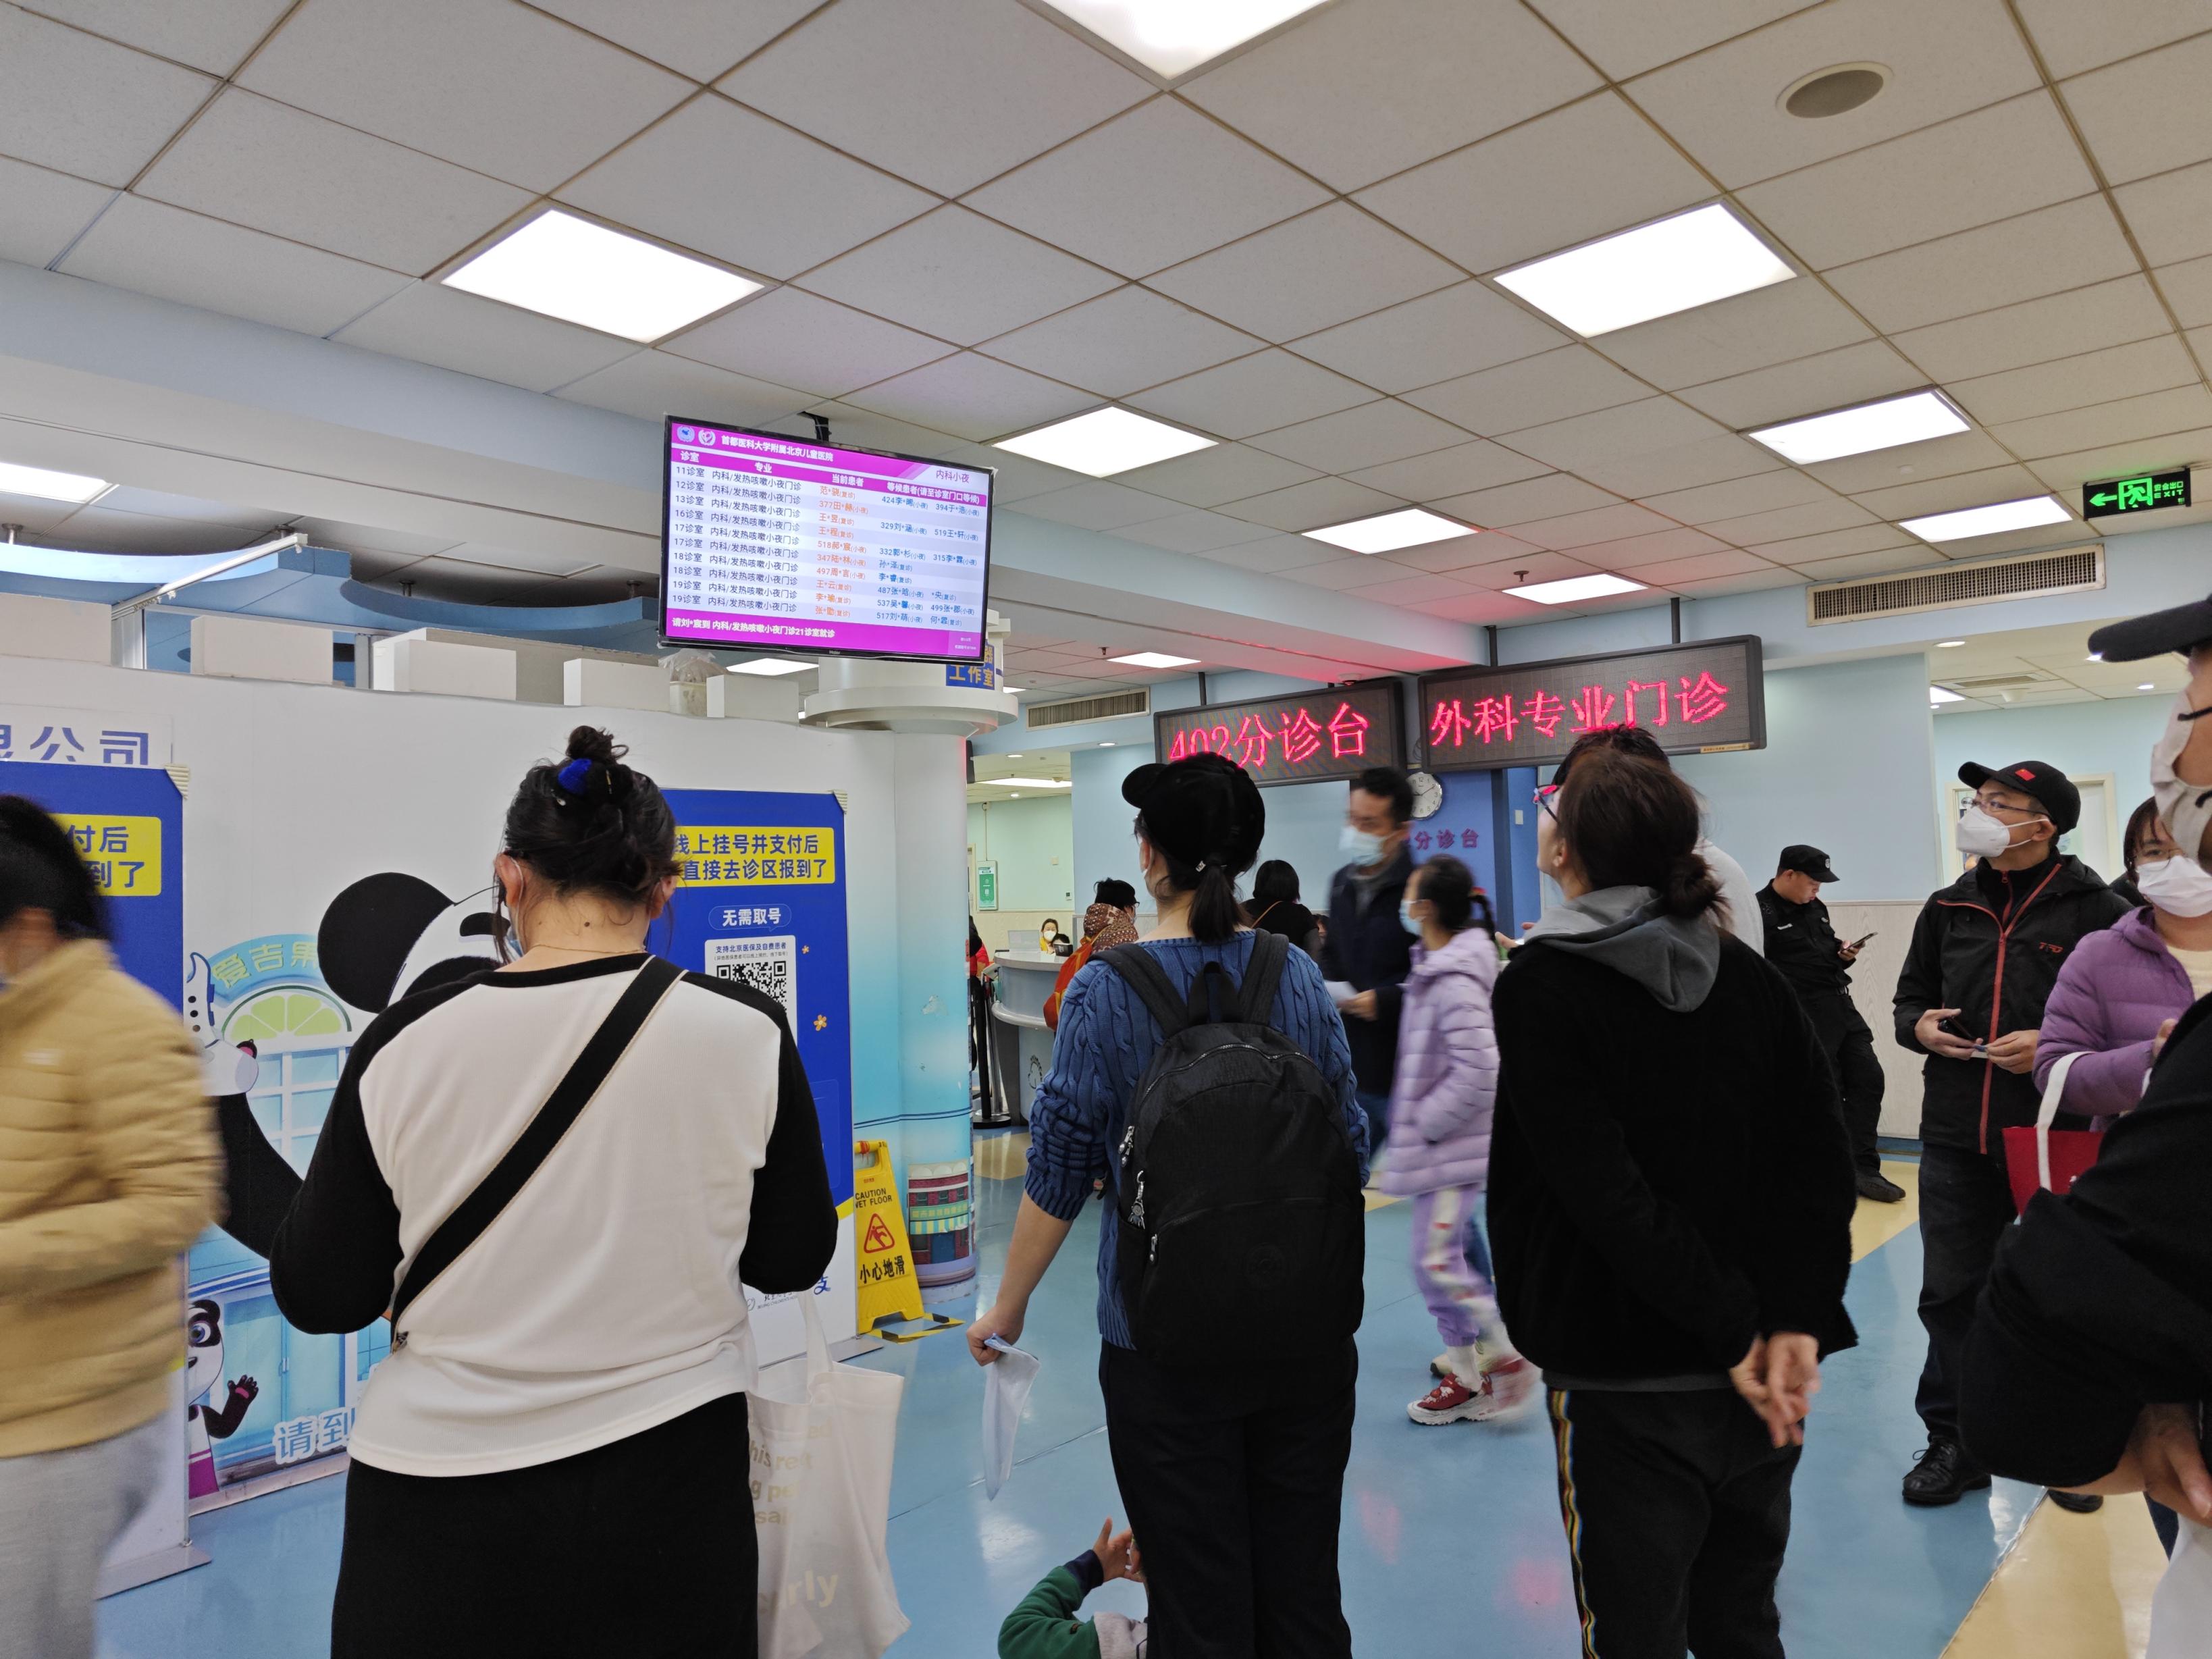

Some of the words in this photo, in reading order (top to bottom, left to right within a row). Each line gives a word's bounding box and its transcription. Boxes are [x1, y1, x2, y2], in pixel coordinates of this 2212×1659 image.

[721, 435, 833, 462] 首都医科大学附属北京儿童医院
[676, 465, 704, 477] 11诊室
[712, 469, 801, 491] 内科/发热咳嗽小夜门诊
[680, 450, 699, 463] 诊室
[754, 462, 772, 473] 专业
[832, 473, 864, 487] 当前患者
[936, 469, 969, 483] 内科小夜
[675, 479, 704, 492] 12诊室
[711, 483, 801, 504] 内科/发热咳嗽小夜门诊
[2154, 490, 2184, 498] EXIT
[675, 493, 704, 506] 13诊室
[711, 498, 800, 518] 内科/发热咳嗽小夜门诊
[675, 508, 703, 520] 16诊室
[710, 512, 799, 531] 内科/发热咳嗽小夜门诊
[674, 522, 703, 534] 17诊室
[710, 526, 799, 546] 内科/发热咳嗽小夜门诊
[674, 536, 702, 548] 17诊室
[710, 540, 799, 559] 内科/发热咳嗽小夜门诊
[673, 550, 702, 562] 18诊室
[709, 554, 798, 573] 内科/发热咳嗽小夜门诊
[673, 565, 702, 577] 18诊室
[709, 569, 797, 586] 内科/发热咳嗽小夜门诊
[673, 579, 701, 591] 19诊室
[708, 583, 797, 599] 内科/发热咳嗽小夜门诊
[673, 594, 701, 605] 19诊室
[708, 596, 797, 612] 内科/发热咳嗽小夜门诊
[949, 664, 993, 687] 工作室
[1431, 672, 1729, 746] 外科专业门诊
[0, 725, 149, 765] 公司
[1169, 702, 1369, 768] 402分诊台
[675, 834, 818, 855] 线上挂号并支付后
[683, 858, 827, 880] 直接去诊区报到了
[722, 907, 781, 926] 无需取号
[716, 942, 787, 953] 支持北京医保及自费患者
[855, 1188, 887, 1201] CAUTION
[870, 1194, 893, 1206] FLOOR
[860, 1255, 905, 1284] 小心地滑
[278, 1407, 355, 1458] 请到
